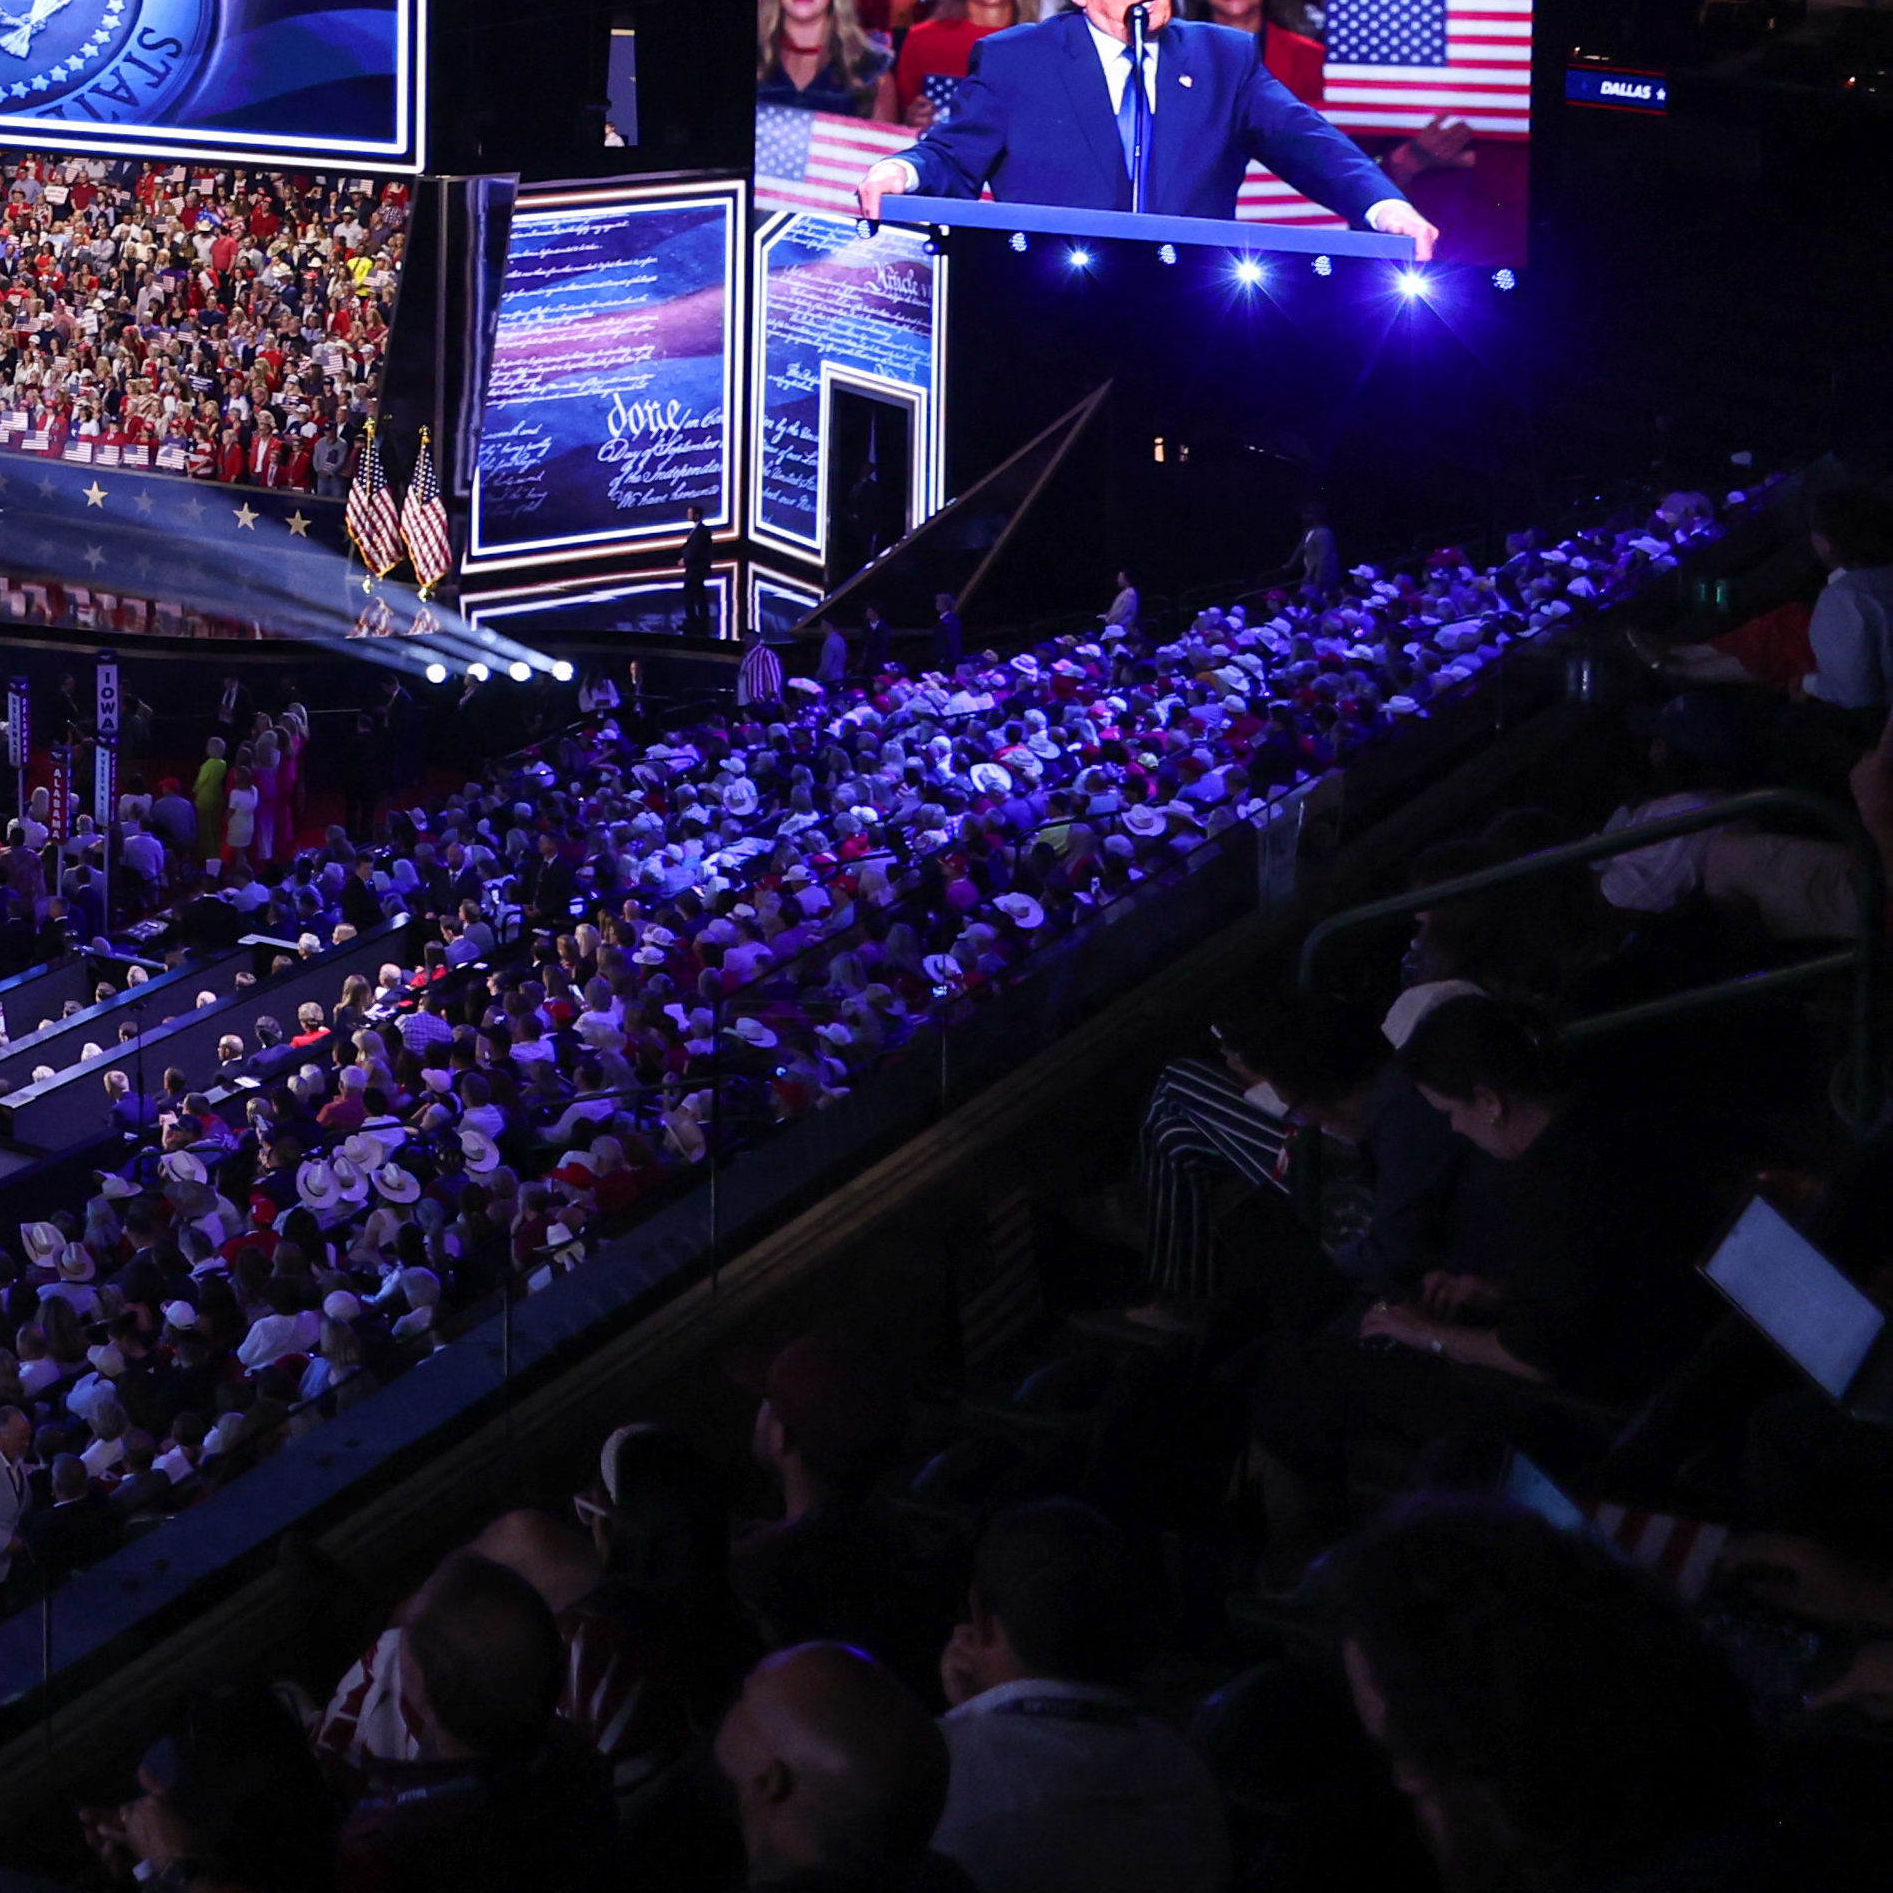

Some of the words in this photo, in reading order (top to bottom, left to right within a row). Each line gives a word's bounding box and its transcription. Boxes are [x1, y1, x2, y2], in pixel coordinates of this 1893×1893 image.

[1600, 81, 1652, 100] DALLAS
[607, 392, 681, 442] done
[597, 439, 641, 471] Day
[655, 432, 721, 468] September
[101, 672, 114, 729] IOWA
[52, 768, 61, 839] ALABAMA
